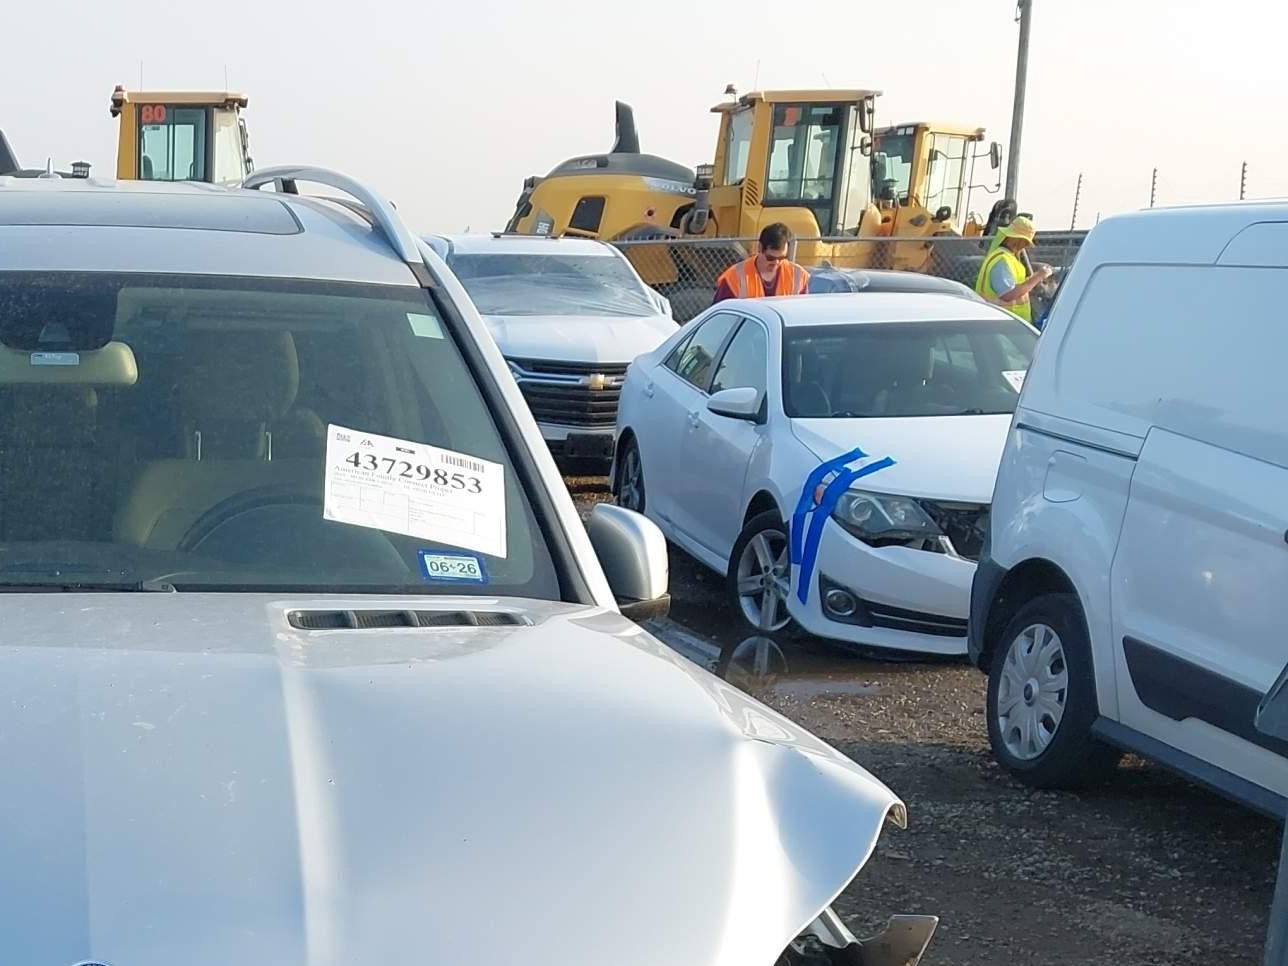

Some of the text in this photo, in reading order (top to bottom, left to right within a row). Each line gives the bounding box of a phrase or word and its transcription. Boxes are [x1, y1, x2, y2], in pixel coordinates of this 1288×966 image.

[141, 105, 167, 123] 80
[345, 451, 483, 494] 43729853
[429, 561, 477, 575] 06 26
